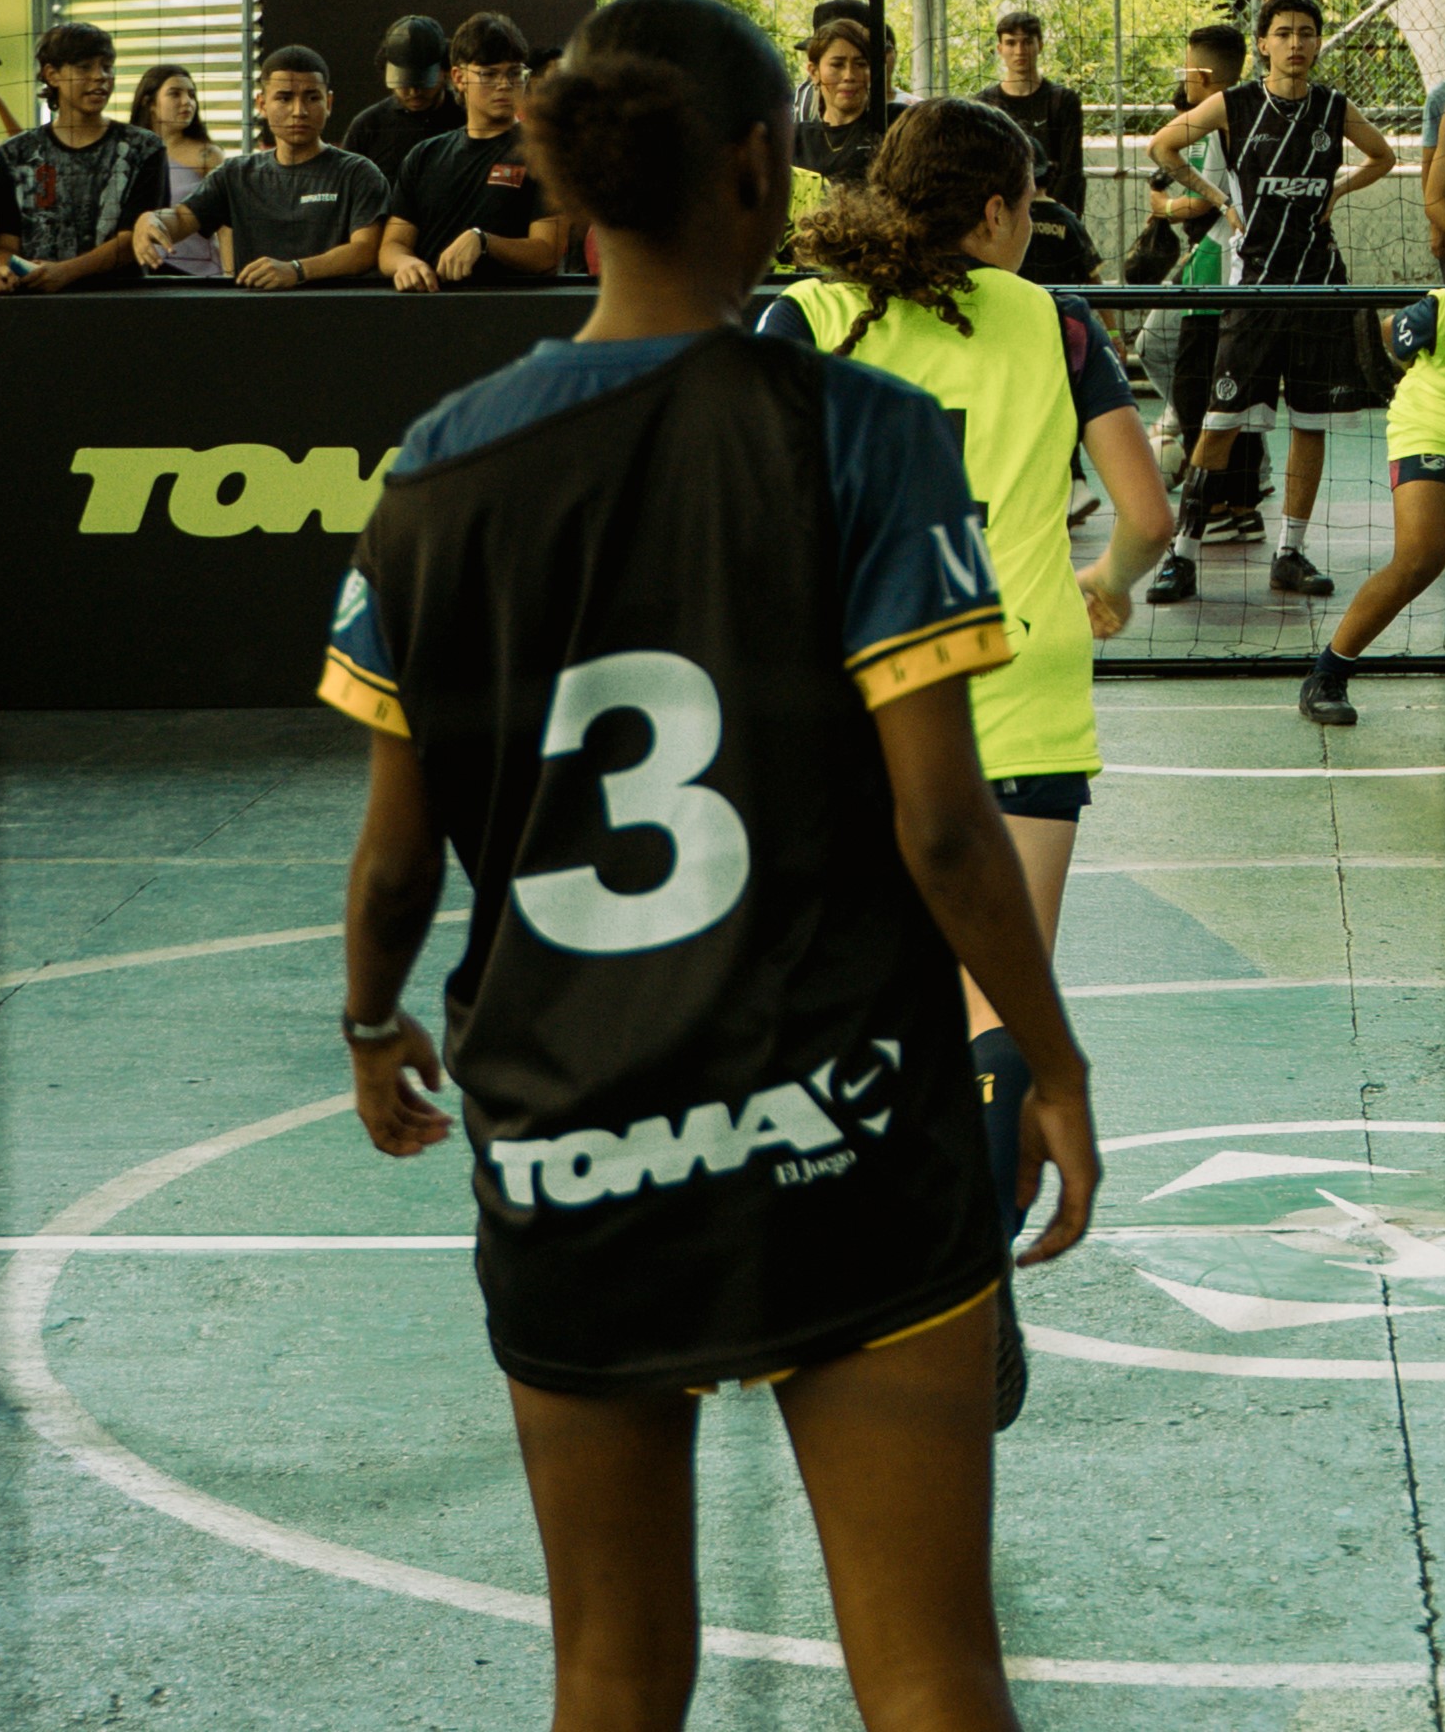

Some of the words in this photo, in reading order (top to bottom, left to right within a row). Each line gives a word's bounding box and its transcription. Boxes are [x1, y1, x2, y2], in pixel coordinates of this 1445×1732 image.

[1256, 176, 1328, 199] MCR
[510, 649, 753, 957] 3
[488, 1080, 846, 1209] TOMA
[773, 1161, 803, 1187] El
